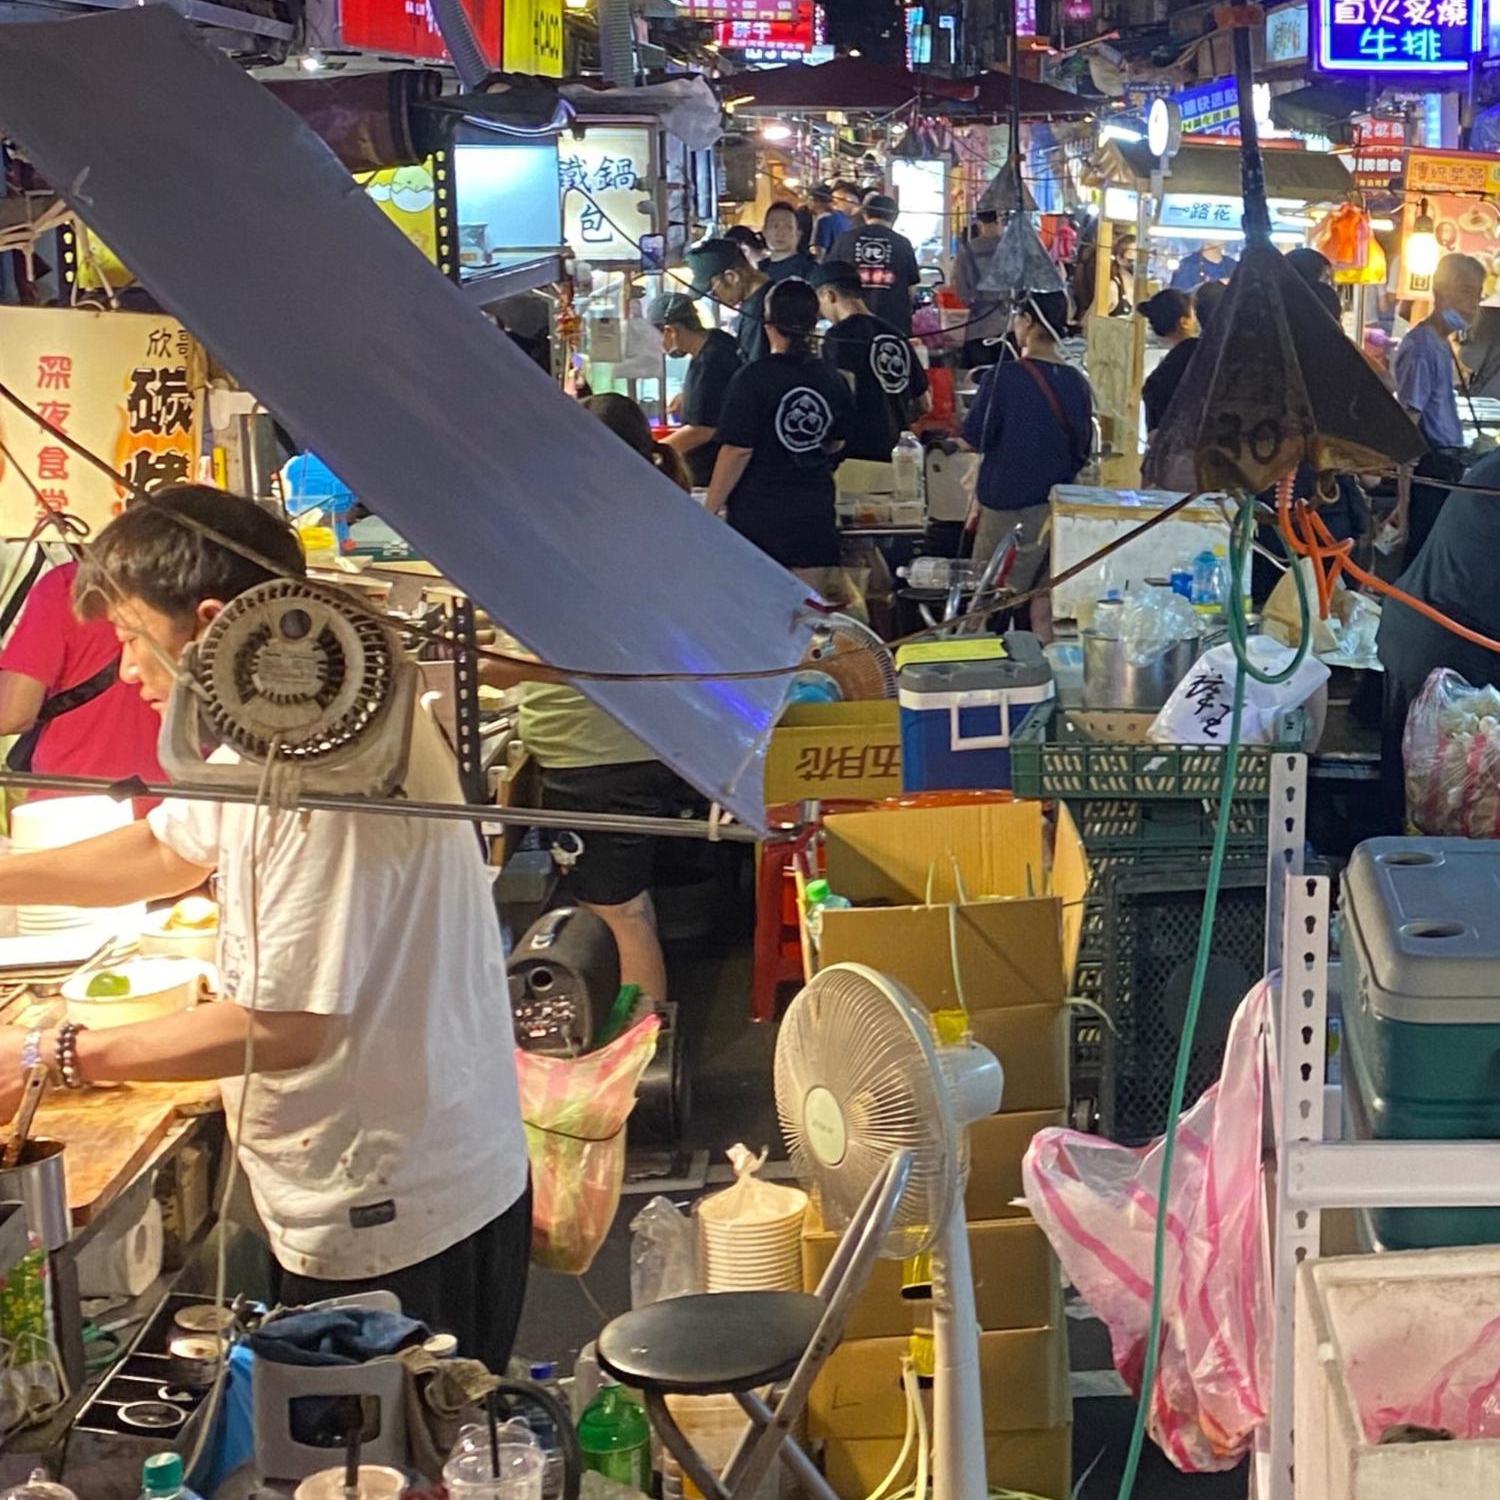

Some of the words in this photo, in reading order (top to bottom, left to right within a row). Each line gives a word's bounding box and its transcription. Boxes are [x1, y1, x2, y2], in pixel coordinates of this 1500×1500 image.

[1360, 27, 1442, 62] 牛排
[580, 204, 613, 243] 包
[35, 355, 73, 522] 深夜食堂
[795, 744, 902, 782] 五月花
